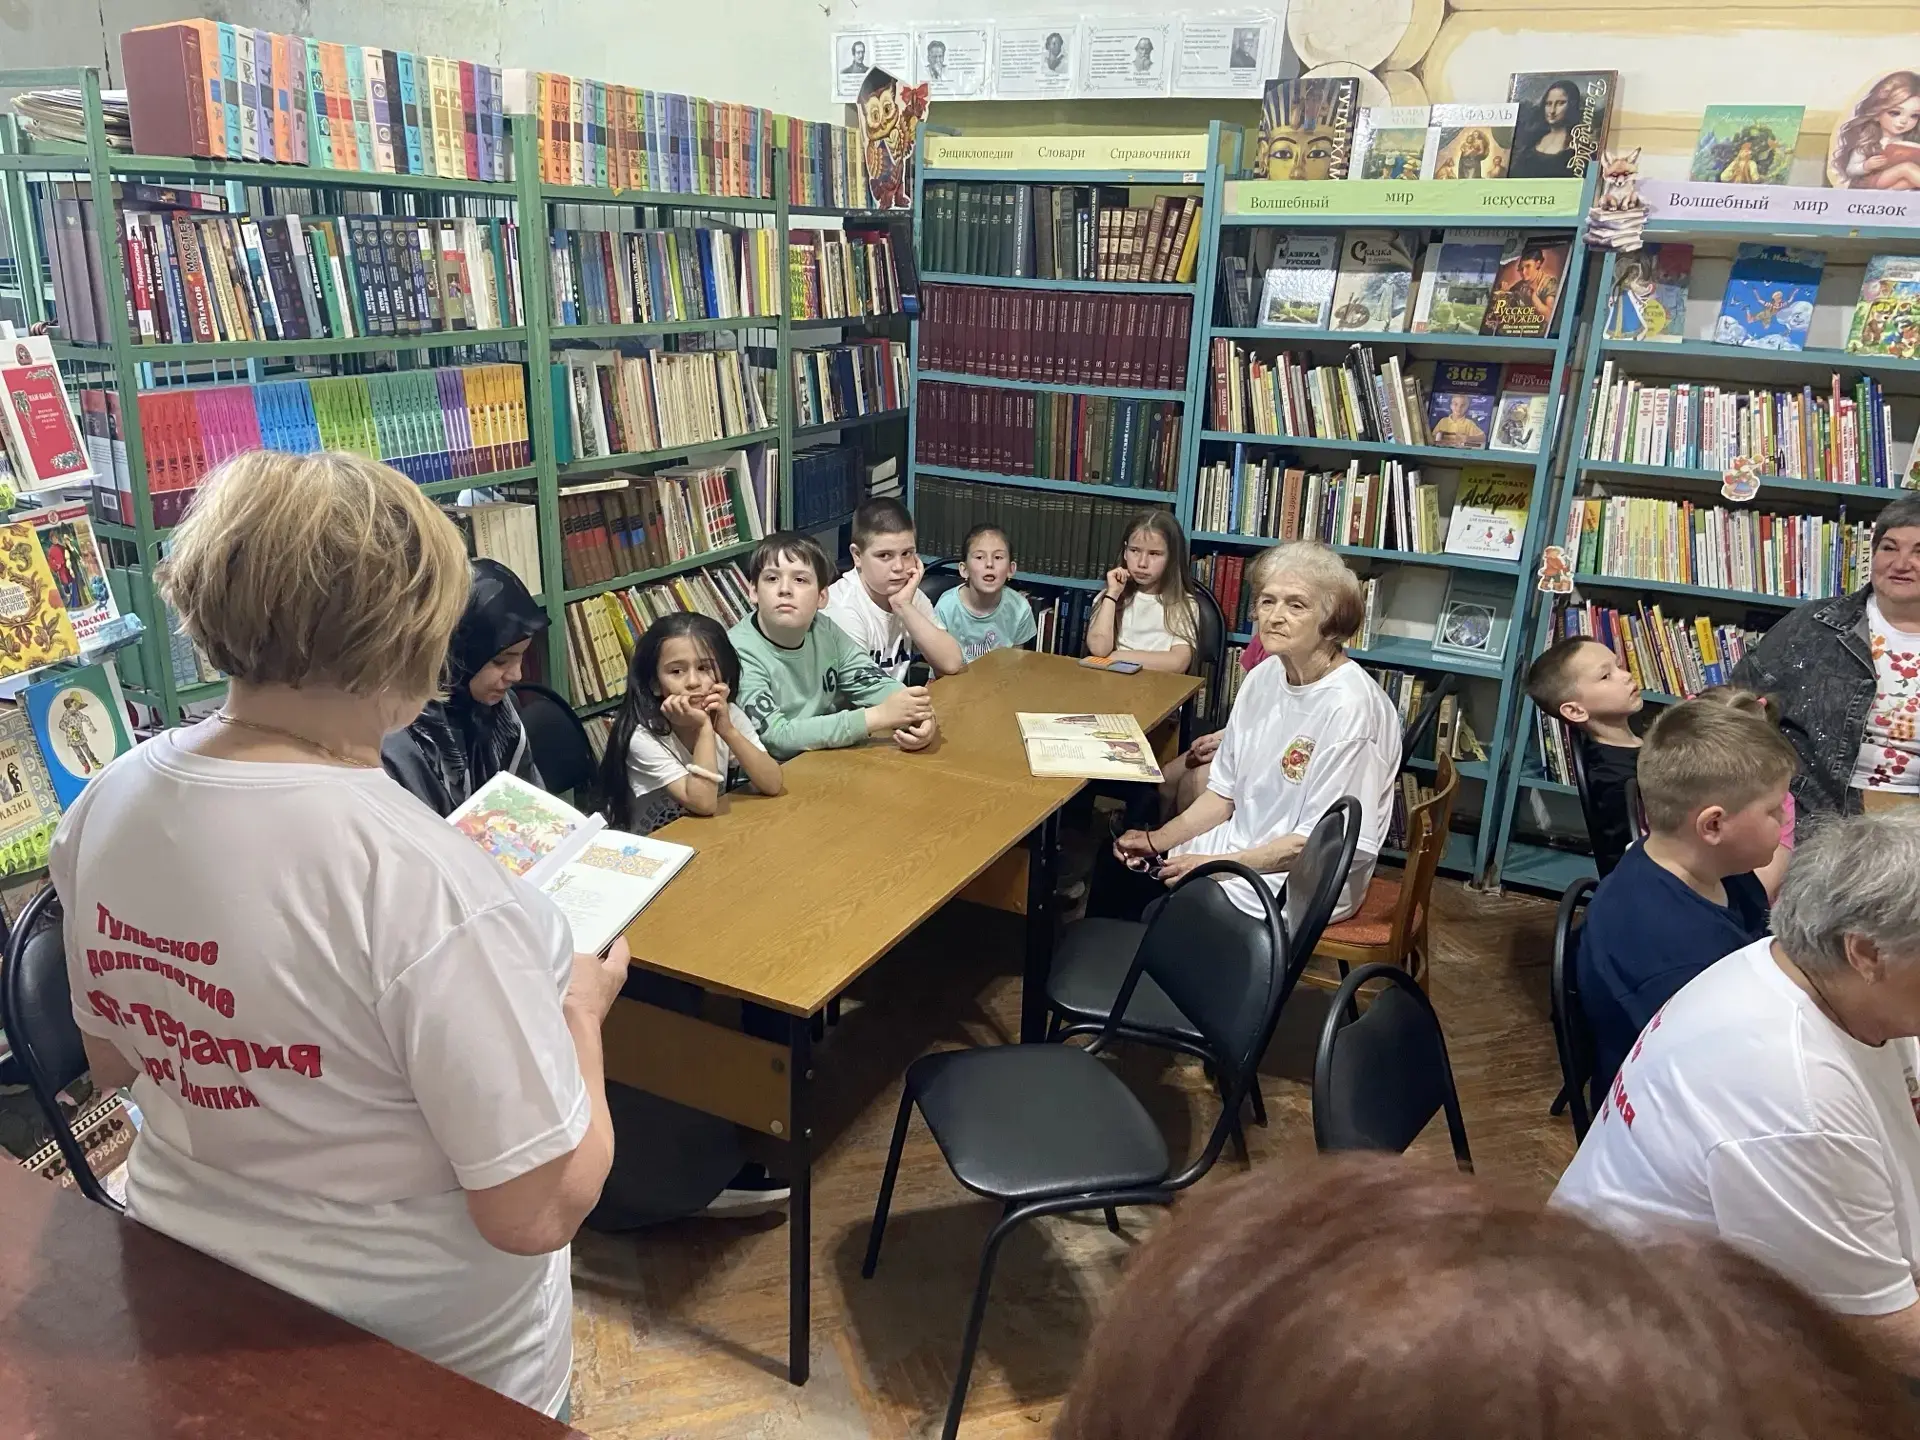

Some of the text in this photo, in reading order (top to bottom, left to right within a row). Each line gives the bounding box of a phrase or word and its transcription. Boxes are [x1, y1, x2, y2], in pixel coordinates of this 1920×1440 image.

[1450, 107, 1513, 121] АФАЭЛЬ
[938, 146, 1191, 162] Энциклопедии Словари Справочники
[1250, 191, 1556, 209] Волшебный мир искусства
[1669, 192, 1908, 217] Волшебный мир сказок
[178, 216, 194, 272] МАСТЕР
[131, 242, 145, 290] Твардовский
[1285, 258, 1321, 266] РУССКОЙ
[1500, 313, 1545, 324] КРУЖЕВО
[1446, 366, 1488, 381] 365
[1460, 482, 1529, 515] Акварель
[96, 901, 219, 966] Тульское
